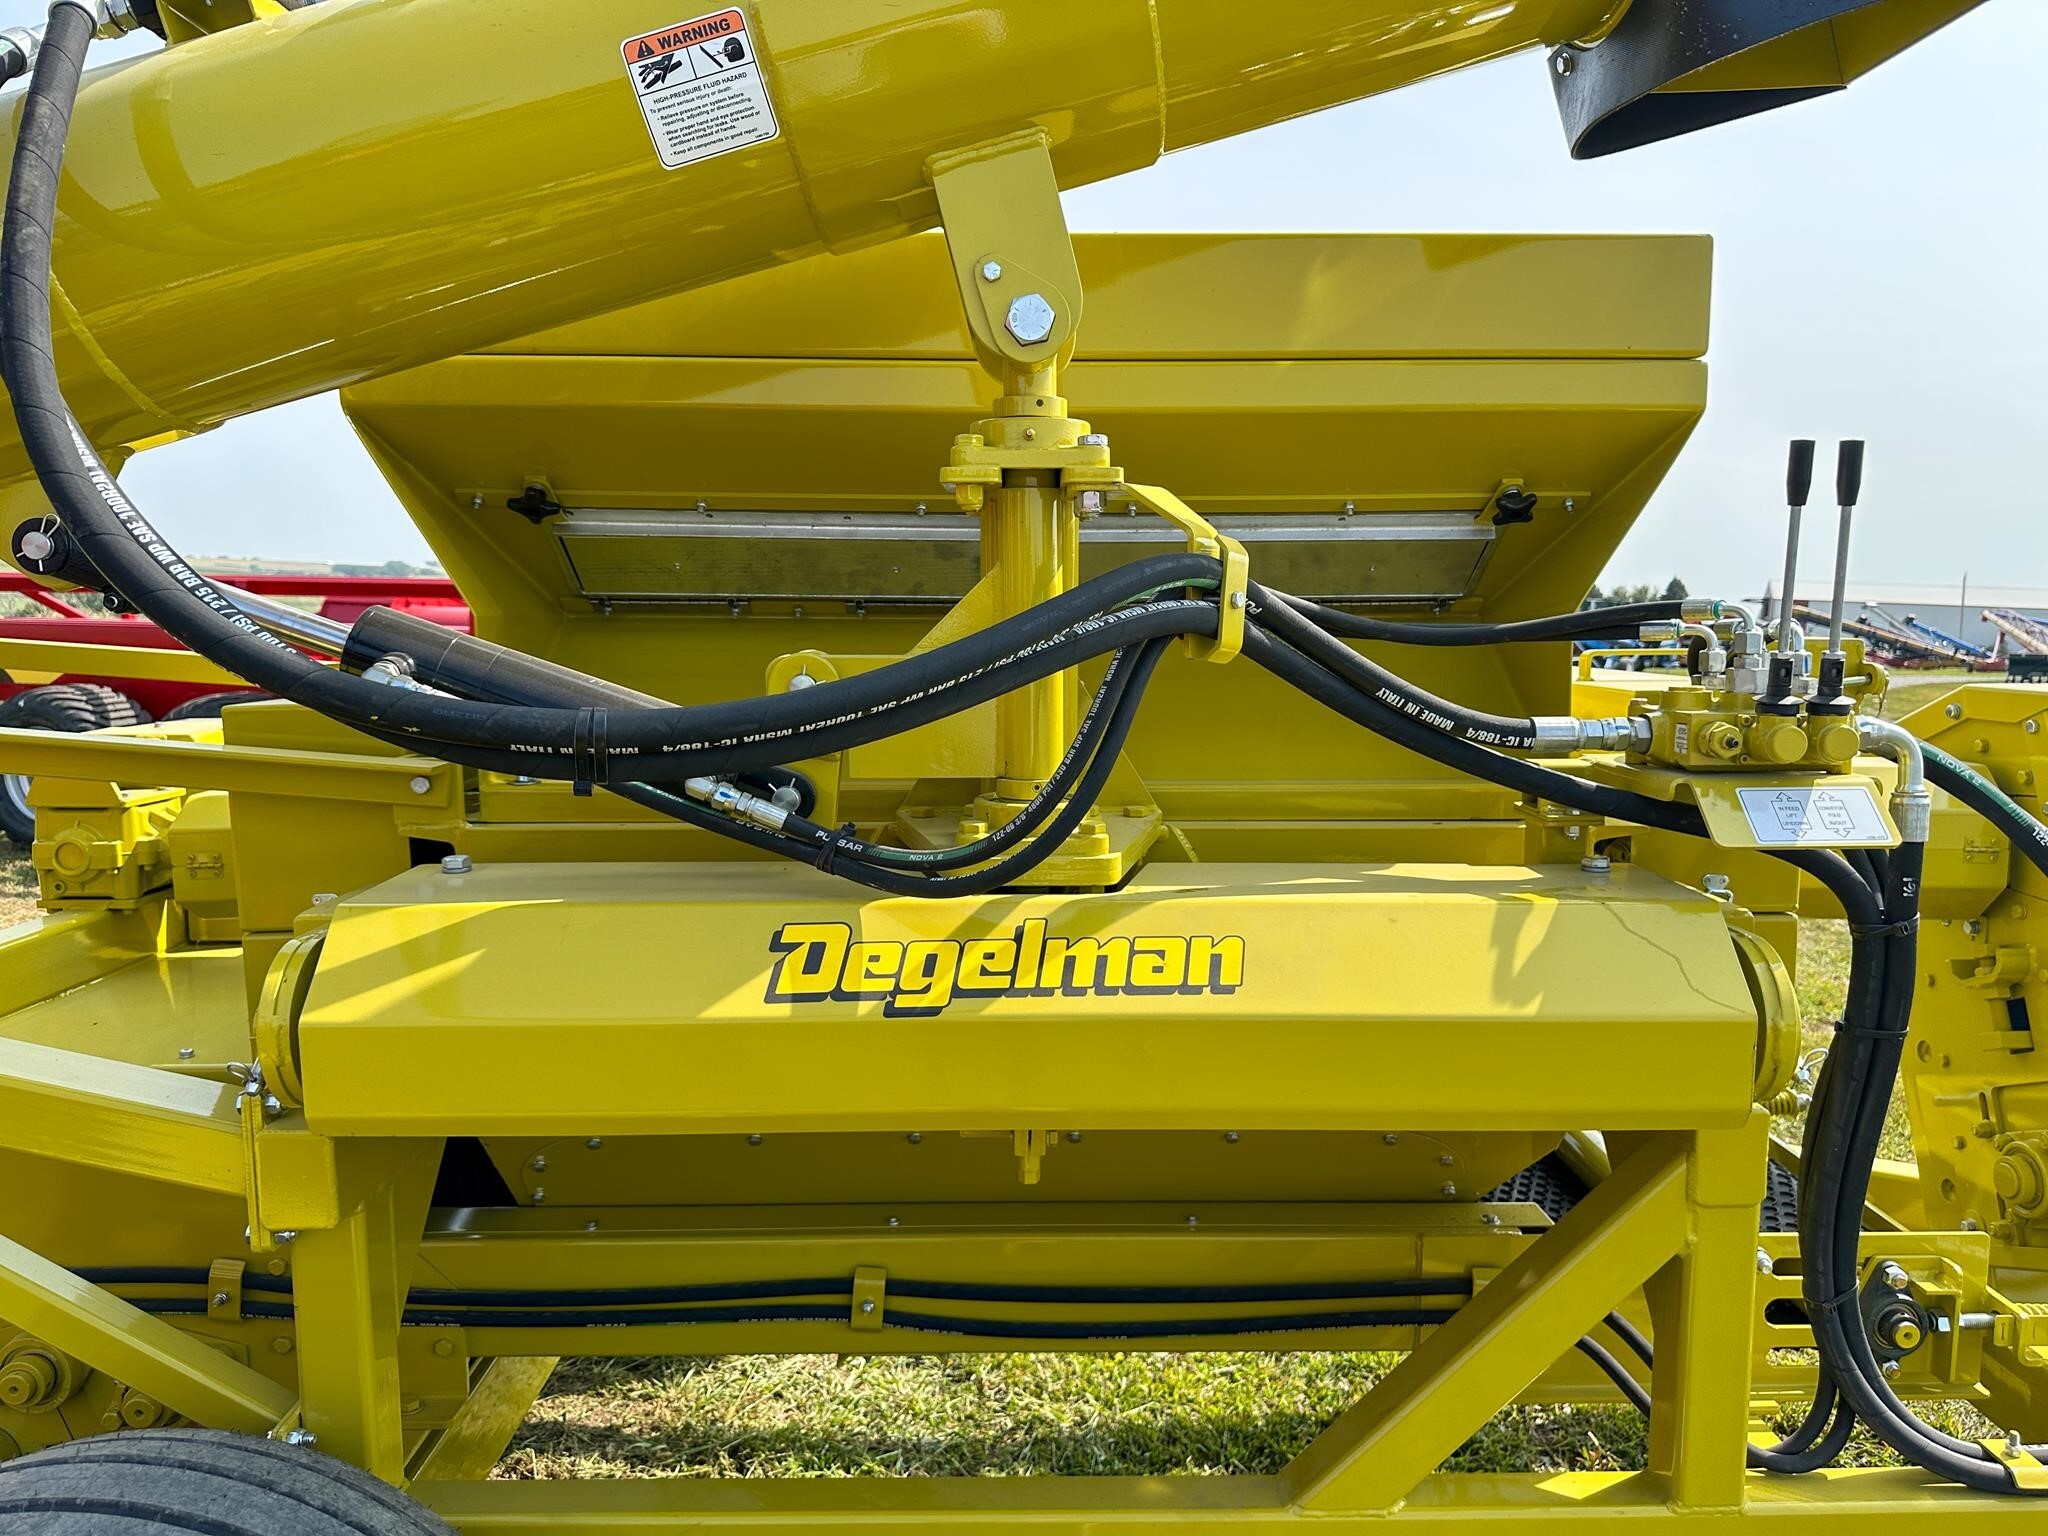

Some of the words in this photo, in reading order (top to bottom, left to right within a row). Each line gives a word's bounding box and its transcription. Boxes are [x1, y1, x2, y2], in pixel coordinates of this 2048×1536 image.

[657, 18, 731, 50] WARNING
[653, 85, 703, 105] HIGH-PRESSURE
[703, 79, 721, 90] FLUID
[722, 72, 748, 85] HAZARD
[657, 103, 676, 113] prevent
[676, 98, 695, 107] serious
[695, 92, 710, 101] injury
[660, 112, 679, 121] Relieve
[680, 105, 701, 116] pressure
[709, 97, 727, 107] system
[727, 92, 744, 101] before
[686, 109, 710, 119] adjusting
[665, 128, 679, 136] Wear
[679, 123, 695, 132] proper
[696, 119, 709, 127] hand
[729, 105, 755, 117] protection
[668, 134, 682, 142] when
[682, 127, 706, 138] searching
[740, 111, 754, 120] wood
[670, 136, 695, 147] cardboard
[695, 130, 714, 139] instead
[673, 148, 687, 156] Keep
[694, 138, 724, 150] components
[730, 131, 743, 140] good
[88, 470, 137, 520] 100R2AT
[126, 520, 158, 543] SAE
[148, 543, 178, 563] WP
[170, 563, 203, 588] BAR
[194, 586, 229, 609] 215
[229, 614, 260, 633] PSI
[1375, 687, 1405, 710] ITALY
[1403, 700, 1421, 717] IN
[1419, 708, 1455, 732] MADE
[1465, 727, 1521, 747] IC-188/4
[992, 822, 1015, 842] 122-06
[1042, 782, 1054, 797] PSI
[1064, 748, 1077, 766] BAR
[1073, 734, 1084, 748] WP
[1081, 717, 1093, 735] SAE
[1105, 659, 1120, 682] MSHA
[1936, 754, 1971, 779] NOVA
[1972, 777, 1982, 787] 2
[815, 830, 863, 853] PUSAR
[909, 853, 935, 861] NOVA
[764, 917, 1247, 1018] Degelman
